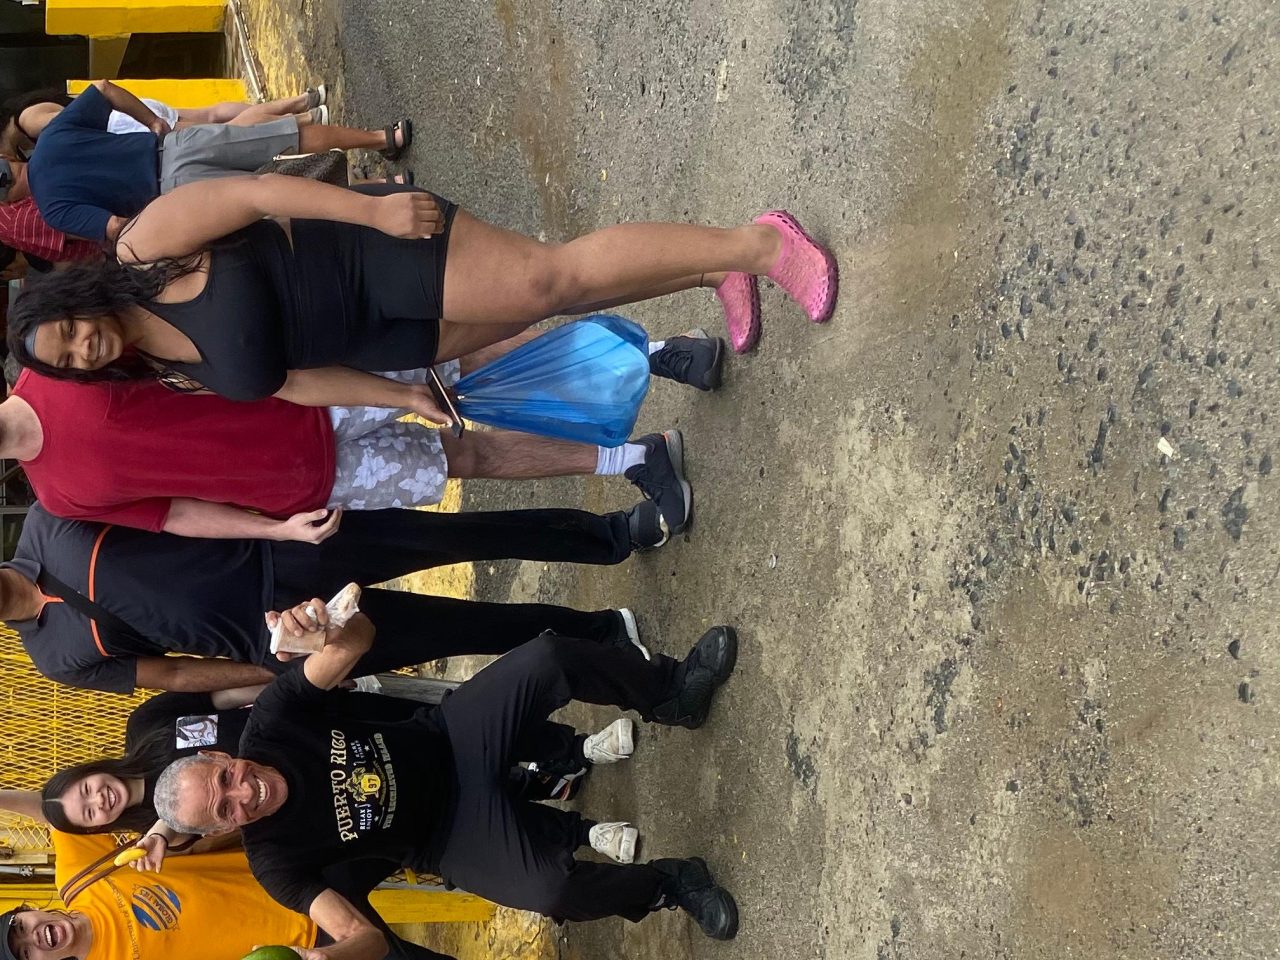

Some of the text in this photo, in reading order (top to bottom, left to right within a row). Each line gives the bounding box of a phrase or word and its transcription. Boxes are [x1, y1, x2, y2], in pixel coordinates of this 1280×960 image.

[331, 730, 358, 841] PUERTO RICO
[367, 777, 377, 789] 97
[152, 899, 173, 923] GLOBAL
